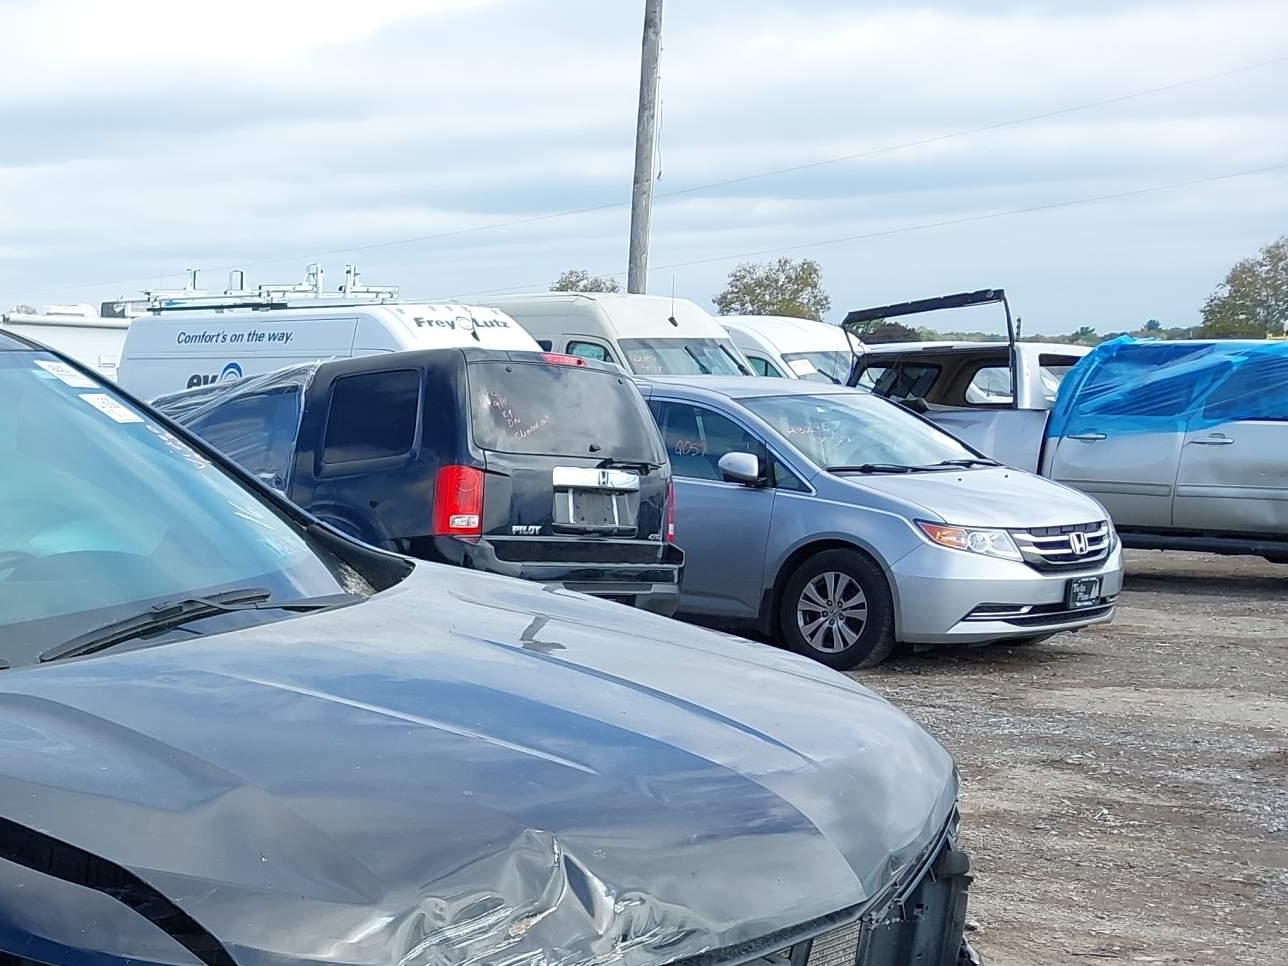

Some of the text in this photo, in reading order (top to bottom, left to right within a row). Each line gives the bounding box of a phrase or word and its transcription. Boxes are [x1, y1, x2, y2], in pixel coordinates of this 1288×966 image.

[414, 316, 456, 330] Frey
[177, 330, 294, 345] Comfort's on the way.
[511, 525, 543, 535] PILOT
